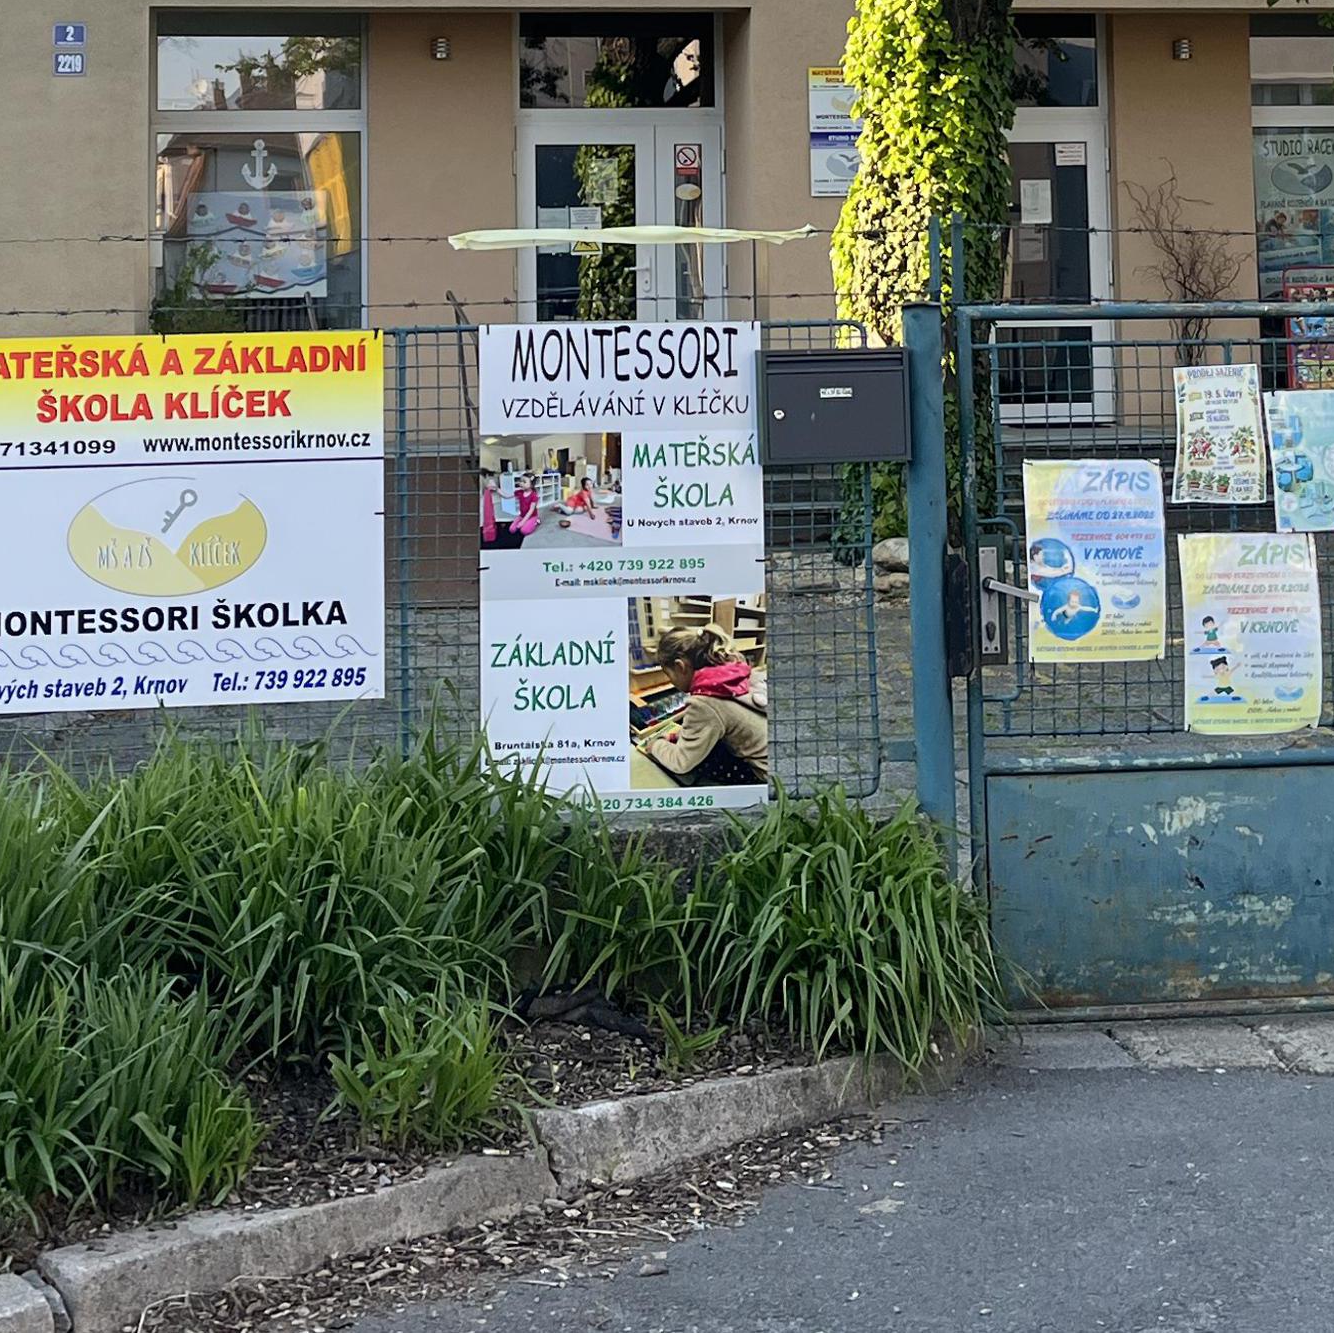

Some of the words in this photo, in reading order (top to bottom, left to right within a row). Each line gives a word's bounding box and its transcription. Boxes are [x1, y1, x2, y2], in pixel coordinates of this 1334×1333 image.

[66, 26, 74, 41] 2
[57, 55, 82, 72] 2219
[1263, 140, 1302, 156] STUDIO
[160, 348, 183, 375] A
[193, 338, 366, 375] ZÁKLADNÍ
[512, 325, 738, 382] MONTESSORI
[36, 388, 153, 423] ŠKOLA
[165, 384, 292, 419] KLÍČEK
[502, 389, 645, 418] VZDĚLÁVÁNÍ
[653, 396, 665, 415] V
[674, 388, 749, 415] KLÍČKU
[0, 439, 116, 457] 71341099
[143, 430, 371, 452] www.montessorikrnov.cz
[632, 433, 755, 468] MATEŘSKÁ
[654, 476, 734, 508] ŠKOLA
[1082, 468, 1151, 493] ZÁPIS
[627, 519, 634, 527] U
[728, 517, 758, 525] Krnov
[123, 545, 132, 569] A
[543, 561, 573, 573] Tel.:
[579, 560, 613, 571] +420
[618, 560, 644, 571] 739
[649, 559, 674, 570] 922
[679, 558, 705, 569] 895
[1084, 547, 1091, 560] V
[1093, 546, 1144, 560] KRNOVĚ
[1238, 541, 1305, 567] ZÁPIS
[212, 599, 347, 629] ŠKOLKA
[1240, 621, 1247, 634] V
[491, 630, 615, 667] ZÁKLADNÍ
[43, 677, 107, 698] staveb
[110, 676, 127, 700] 2,
[134, 675, 188, 694] Krnov
[213, 672, 249, 692] Tel.:
[254, 670, 288, 690] 739
[292, 668, 327, 688] 922
[331, 667, 367, 687] 895
[514, 678, 596, 711] ŠKOLA
[584, 739, 616, 747] Krnov
[625, 798, 652, 809] 734
[657, 796, 683, 808] 384
[687, 795, 714, 807] 426
